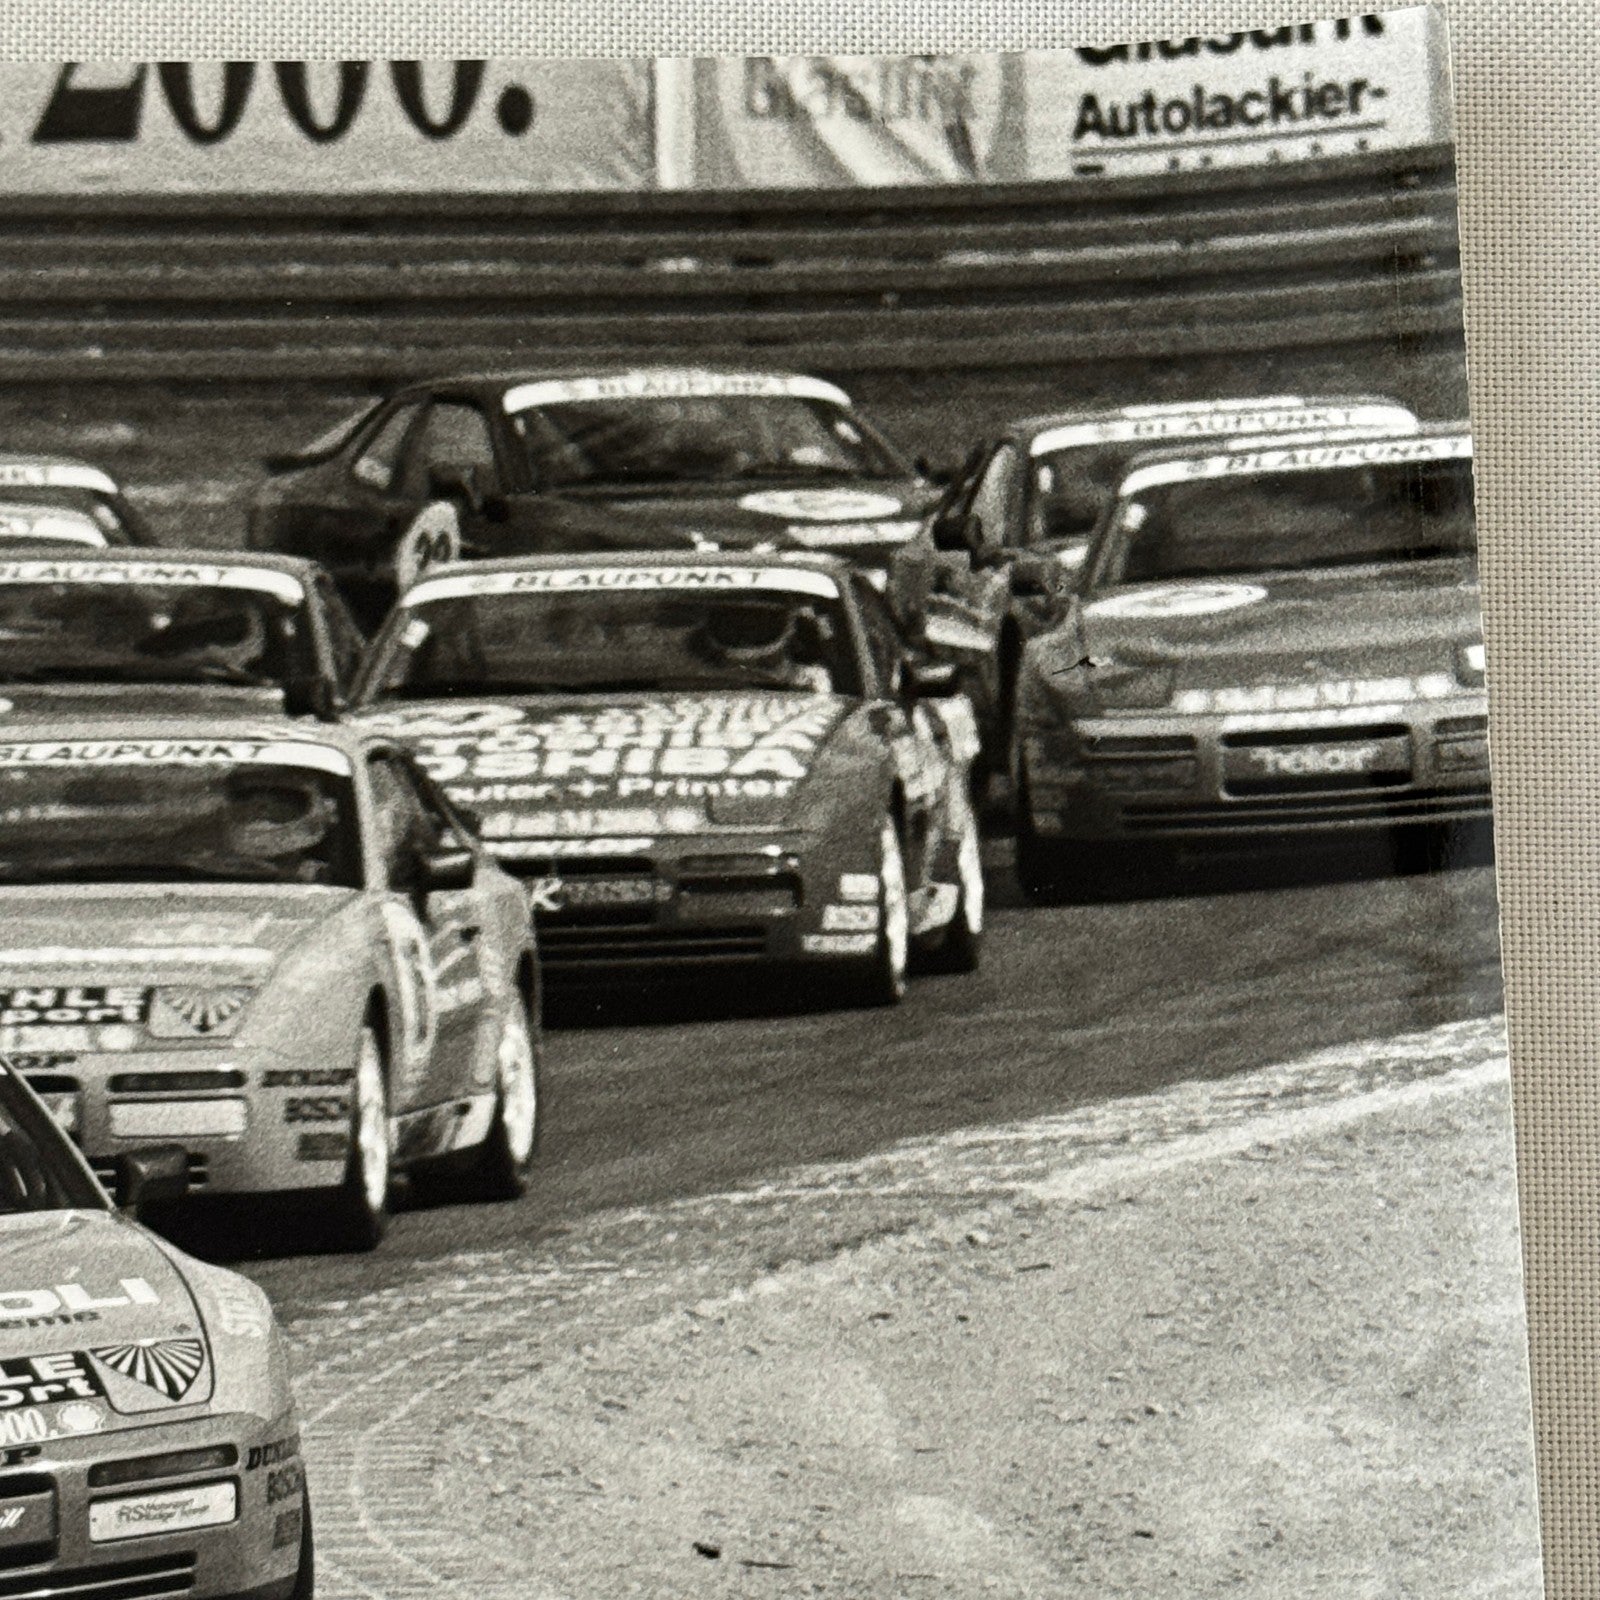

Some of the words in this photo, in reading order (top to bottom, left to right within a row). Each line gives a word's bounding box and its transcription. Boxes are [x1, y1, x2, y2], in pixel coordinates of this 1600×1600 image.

[1073, 72, 1388, 140] Autolackier-
[512, 571, 762, 588] BLAUPUNKT
[617, 776, 797, 799] Printer
